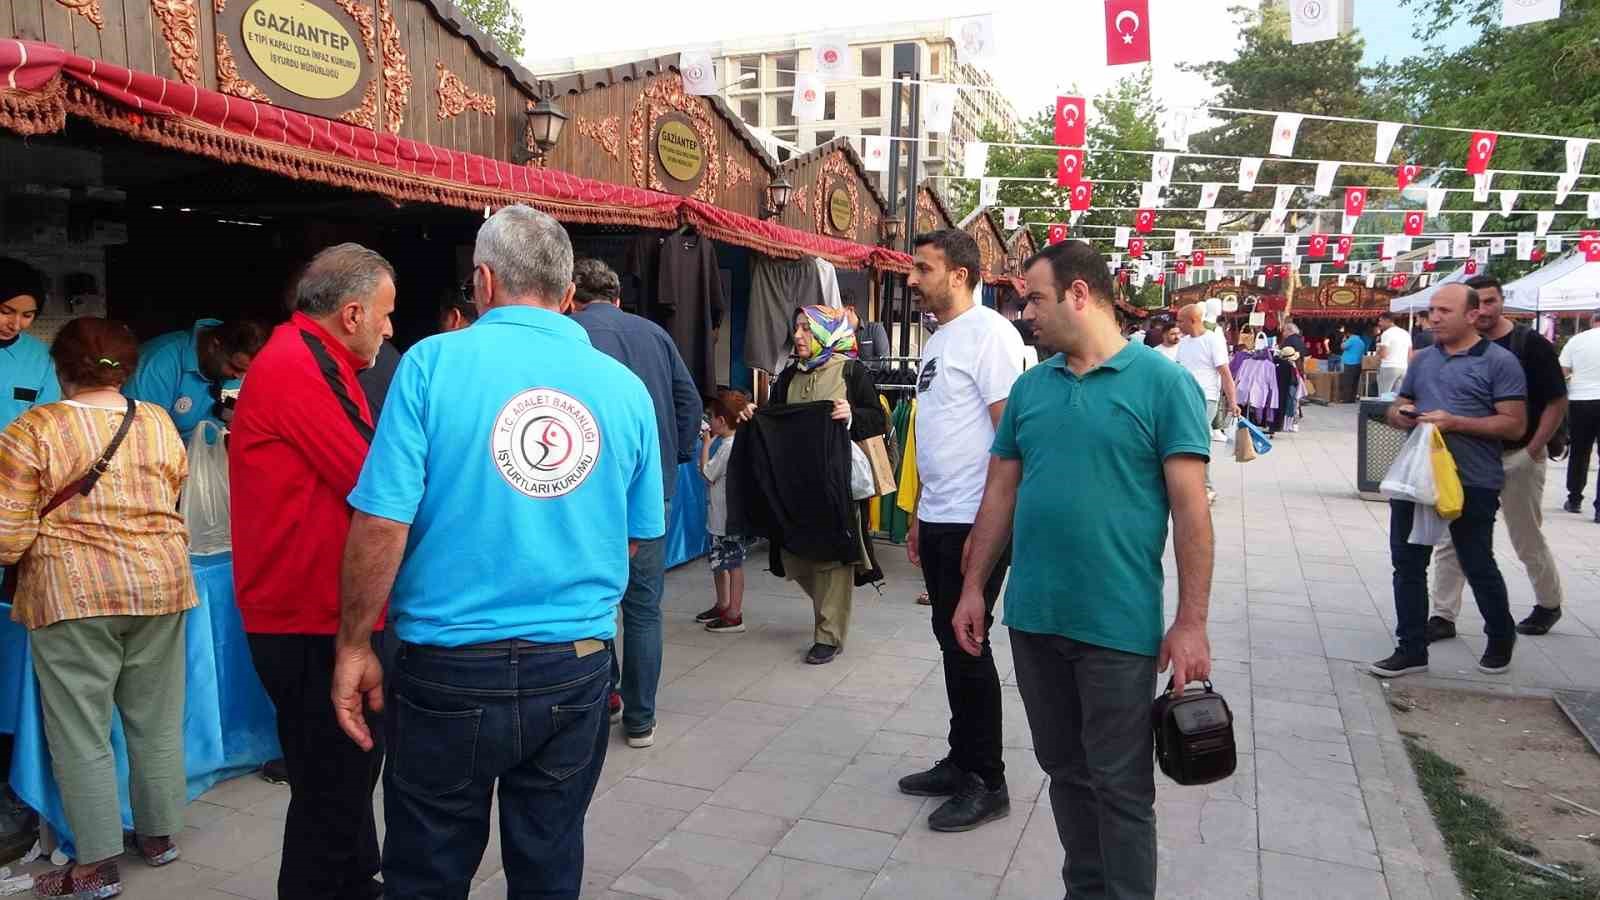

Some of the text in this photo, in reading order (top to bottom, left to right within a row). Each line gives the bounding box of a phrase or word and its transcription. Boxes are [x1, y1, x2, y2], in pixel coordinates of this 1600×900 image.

[248, 32, 254, 41] E
[254, 33, 268, 46] TİPİ
[269, 38, 293, 52] KAPALI
[294, 45, 311, 57] CEZA
[253, 9, 350, 51] GAZİANTEP
[513, 395, 550, 416] ADALET
[552, 397, 596, 443] BAKANLIĞI
[551, 454, 593, 493] KURUMU
